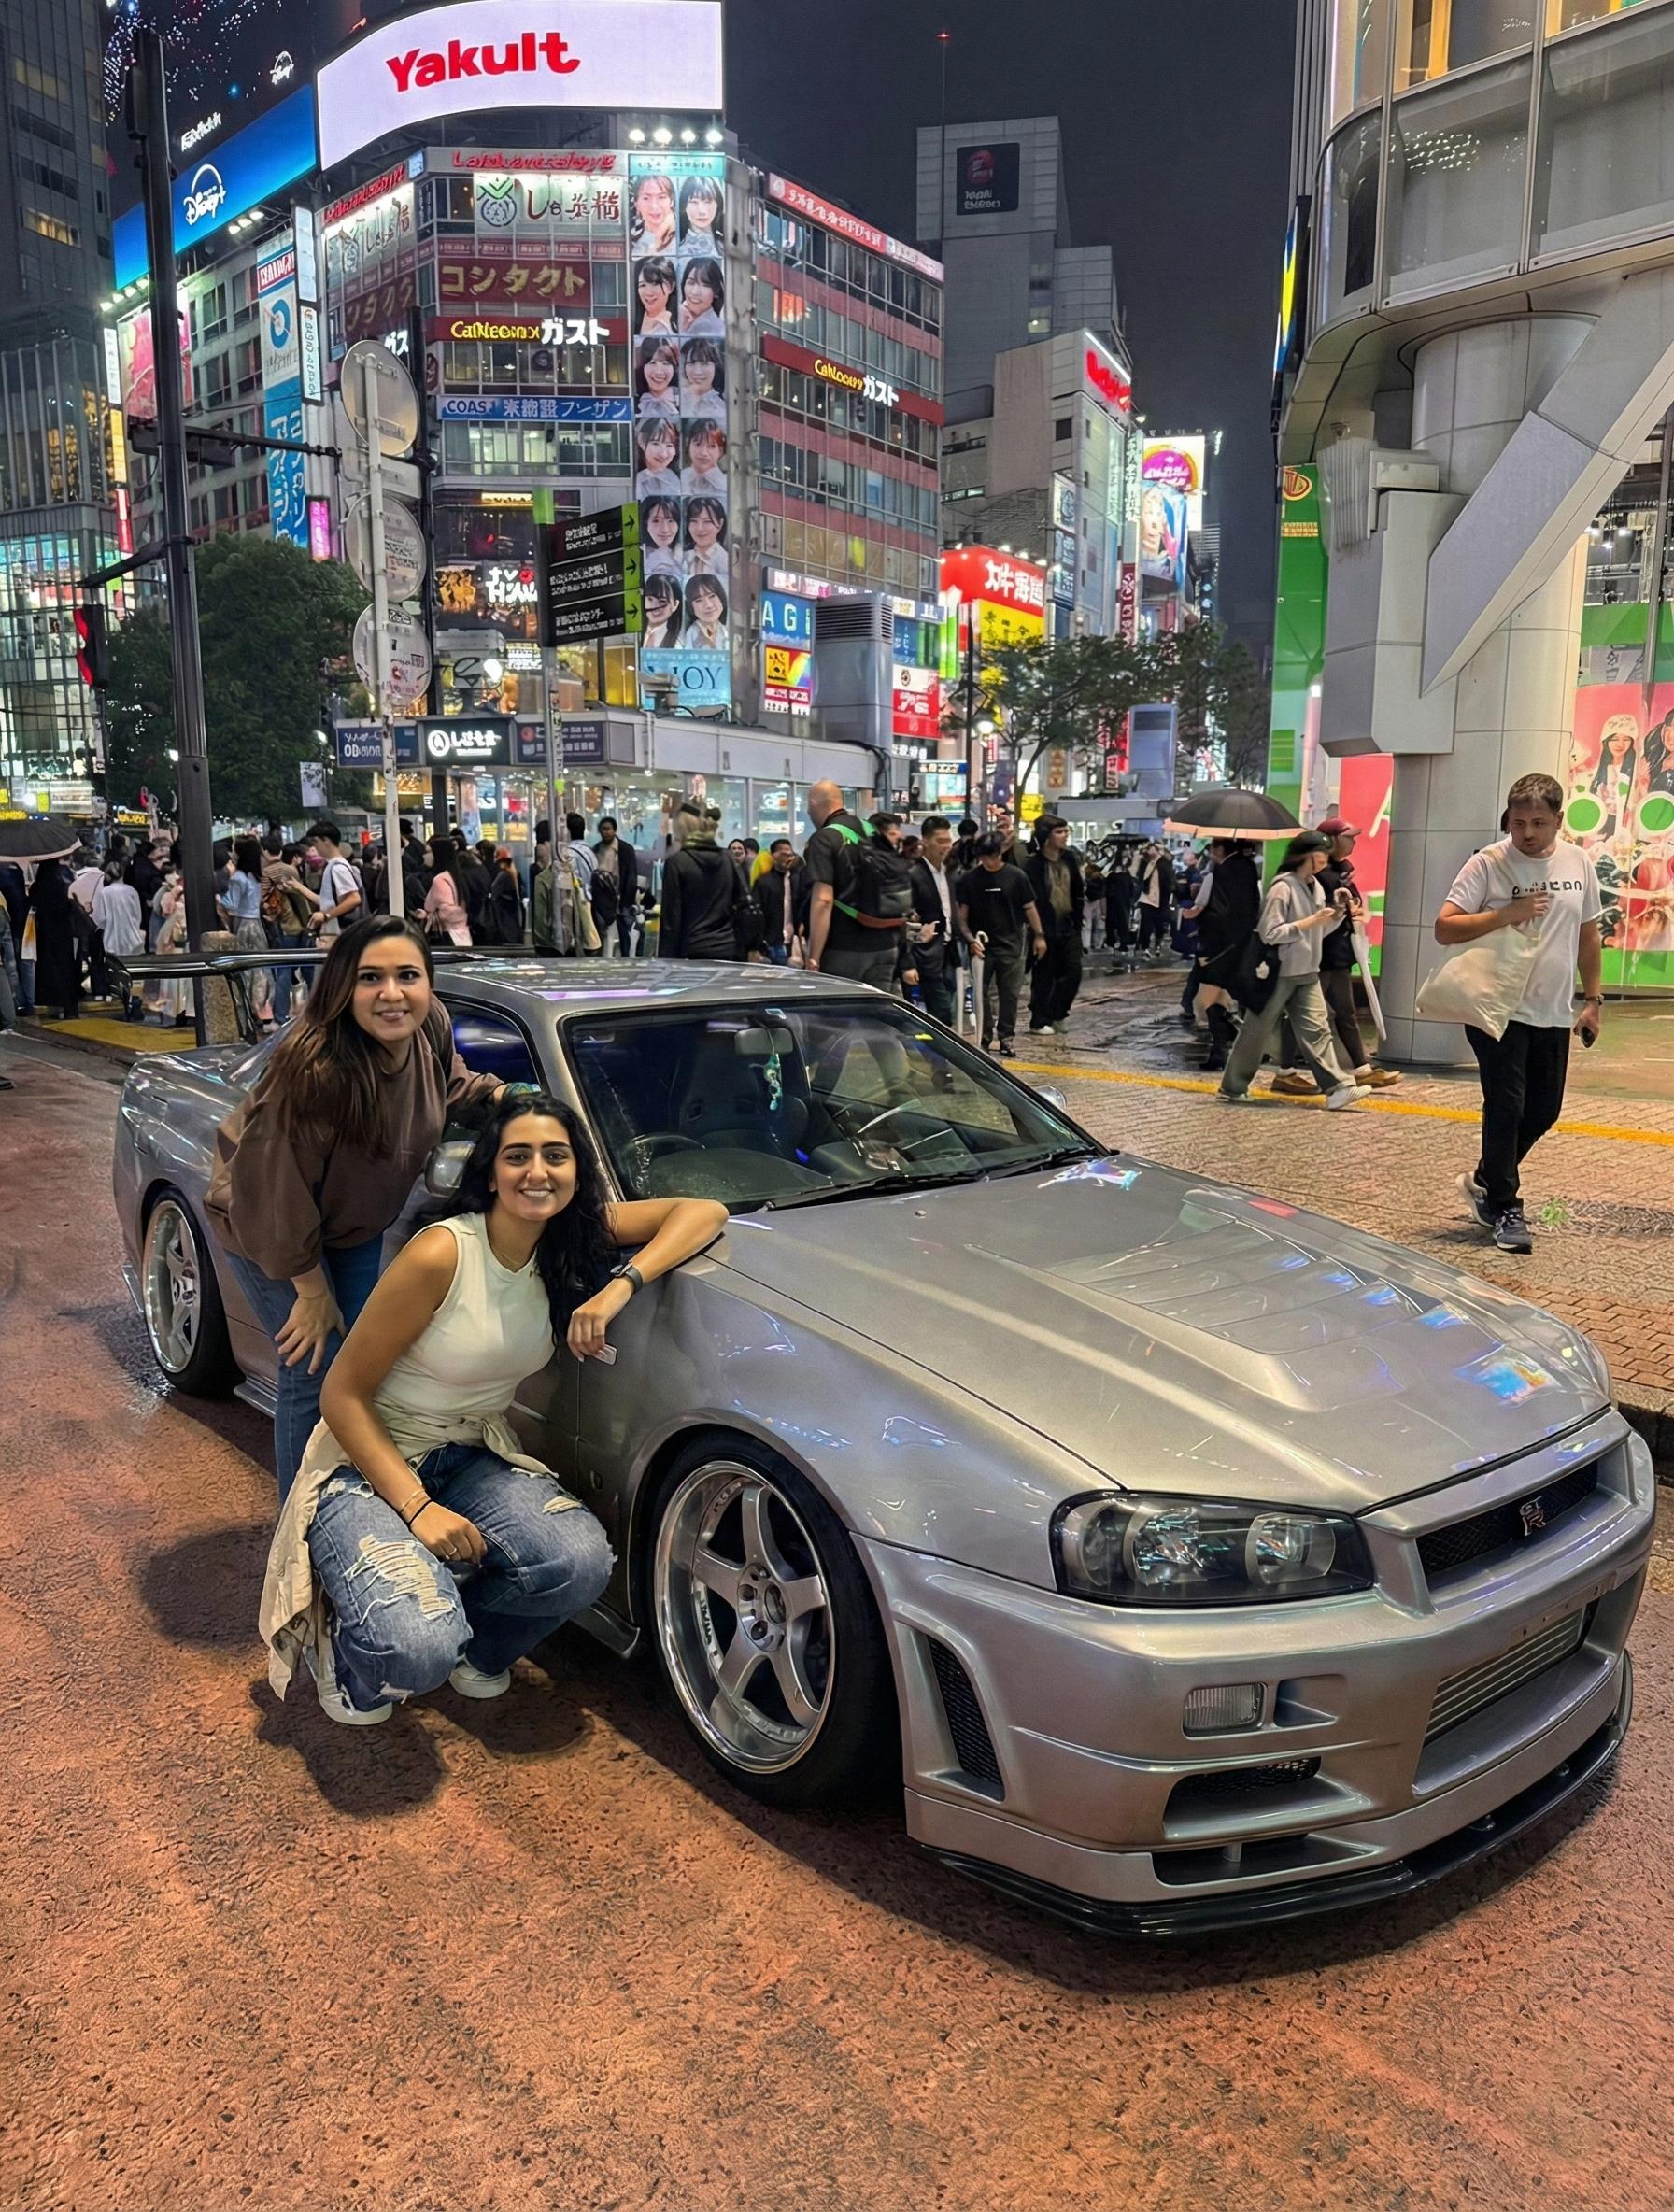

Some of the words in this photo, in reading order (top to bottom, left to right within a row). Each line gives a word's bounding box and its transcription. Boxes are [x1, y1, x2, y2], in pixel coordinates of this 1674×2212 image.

[386, 32, 581, 92] Yakult
[442, 263, 585, 296] コンタクト
[541, 318, 610, 346] ガスト
[863, 374, 900, 407] ガスト
